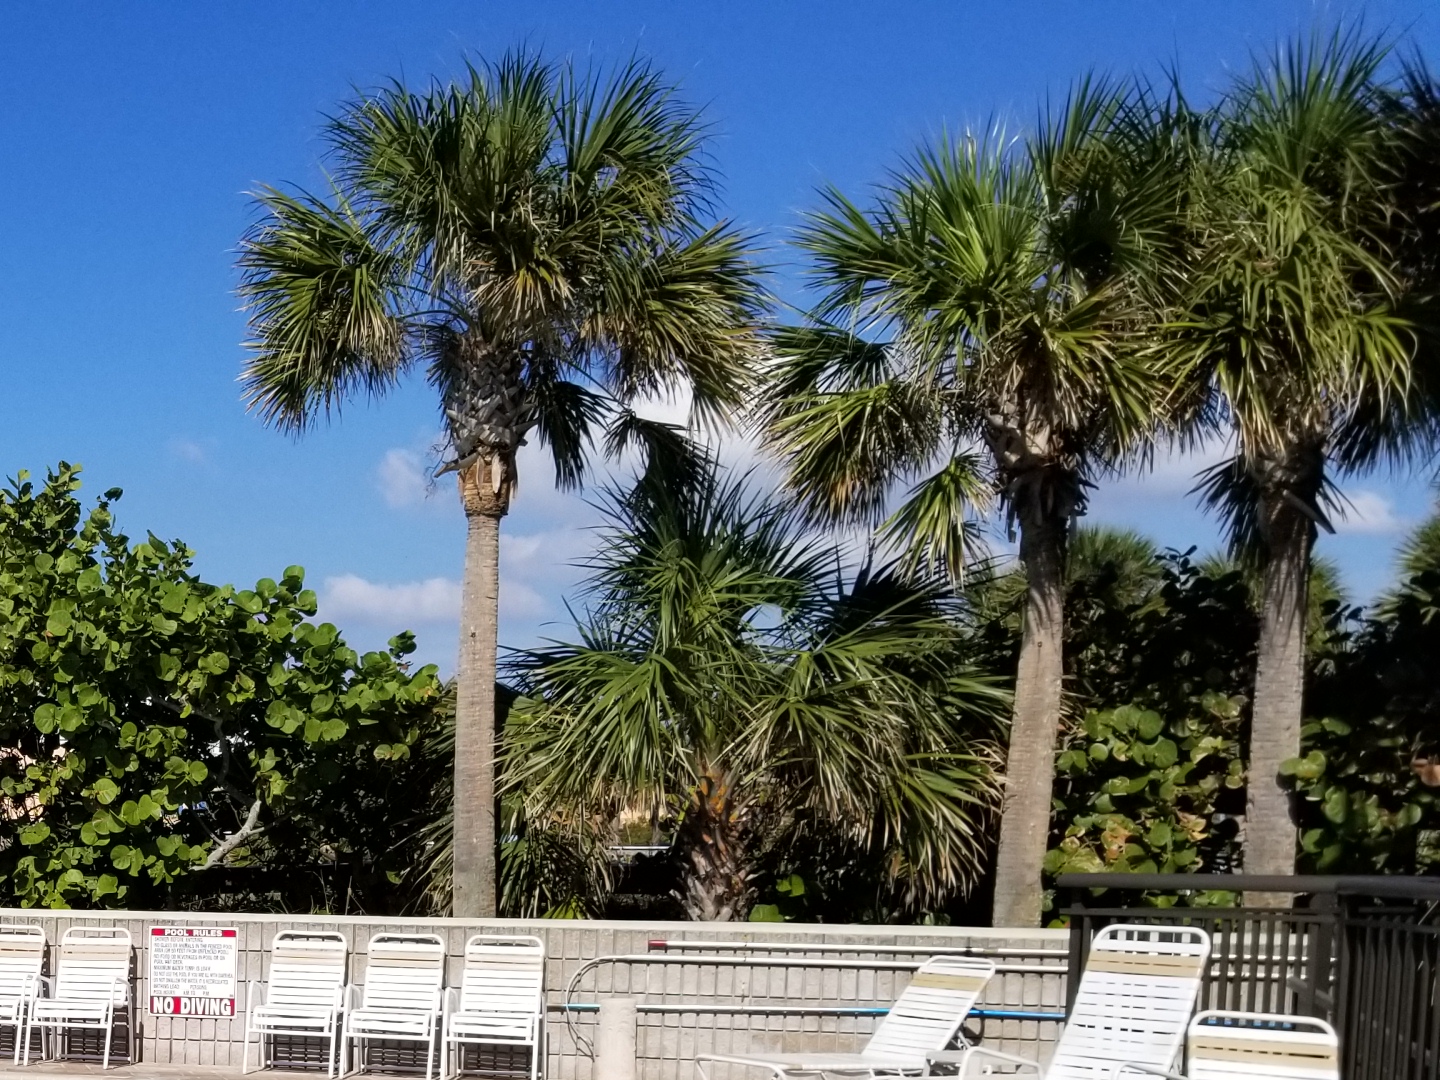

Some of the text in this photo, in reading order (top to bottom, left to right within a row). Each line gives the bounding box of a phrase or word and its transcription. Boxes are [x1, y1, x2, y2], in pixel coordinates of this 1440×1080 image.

[193, 929, 222, 937] RULES
[154, 997, 231, 1016] NO DIVING
